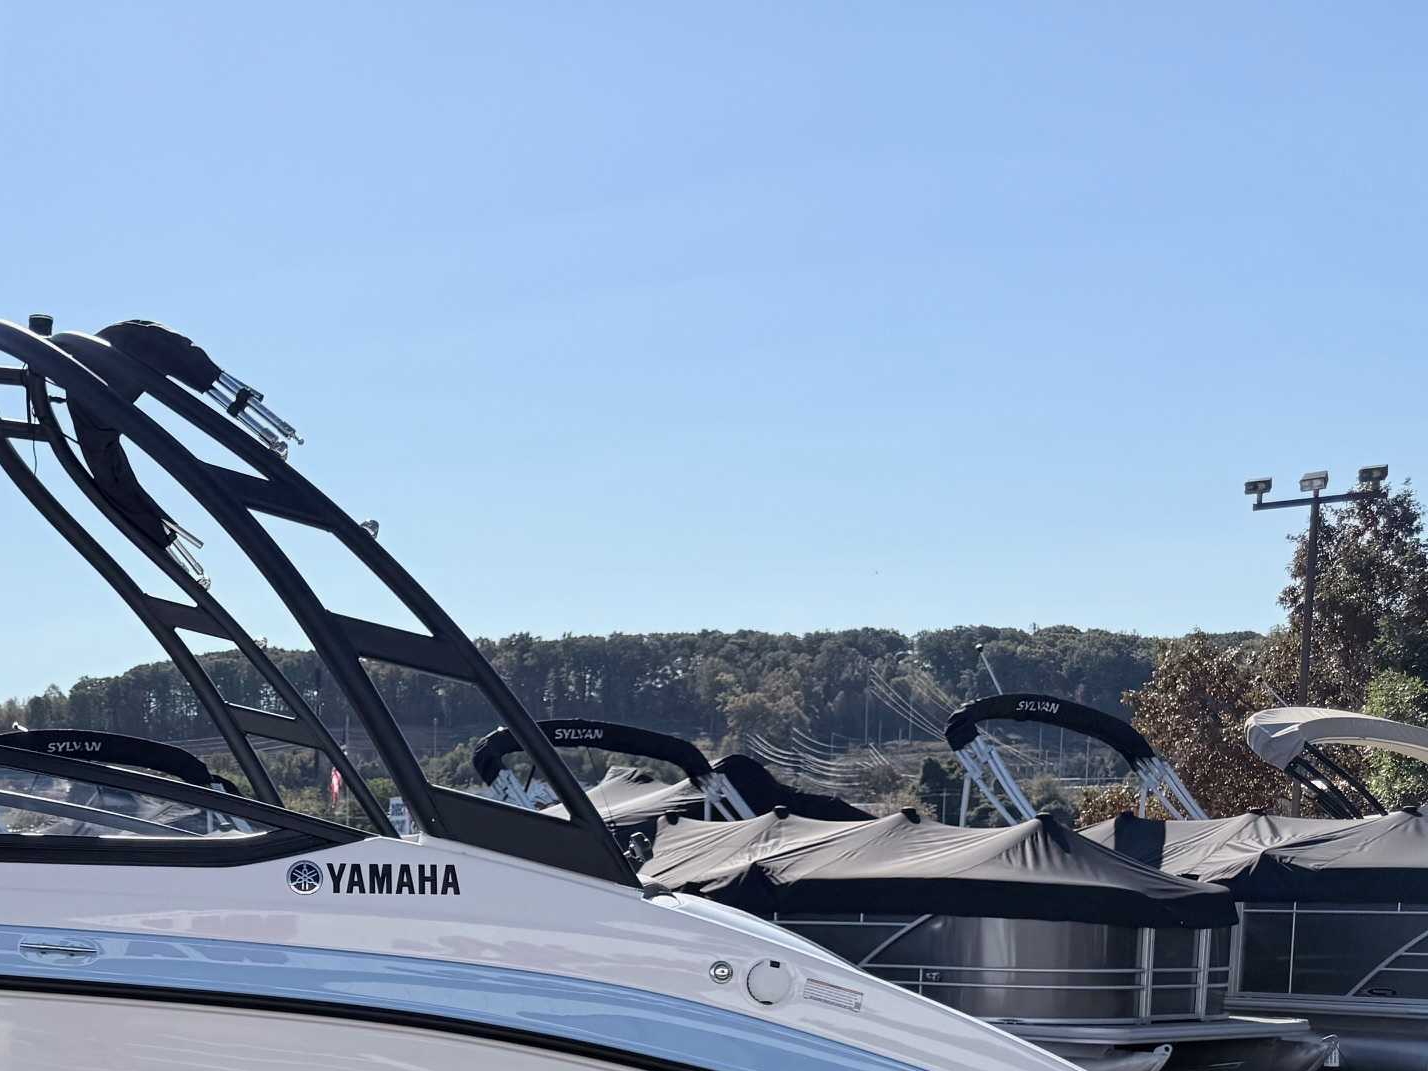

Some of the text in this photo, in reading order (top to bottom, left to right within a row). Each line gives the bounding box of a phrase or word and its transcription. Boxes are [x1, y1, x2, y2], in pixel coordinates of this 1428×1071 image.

[1016, 700, 1060, 714] SYLVAN
[555, 728, 603, 739] SYLVAN
[327, 863, 460, 895] YAMAHA
